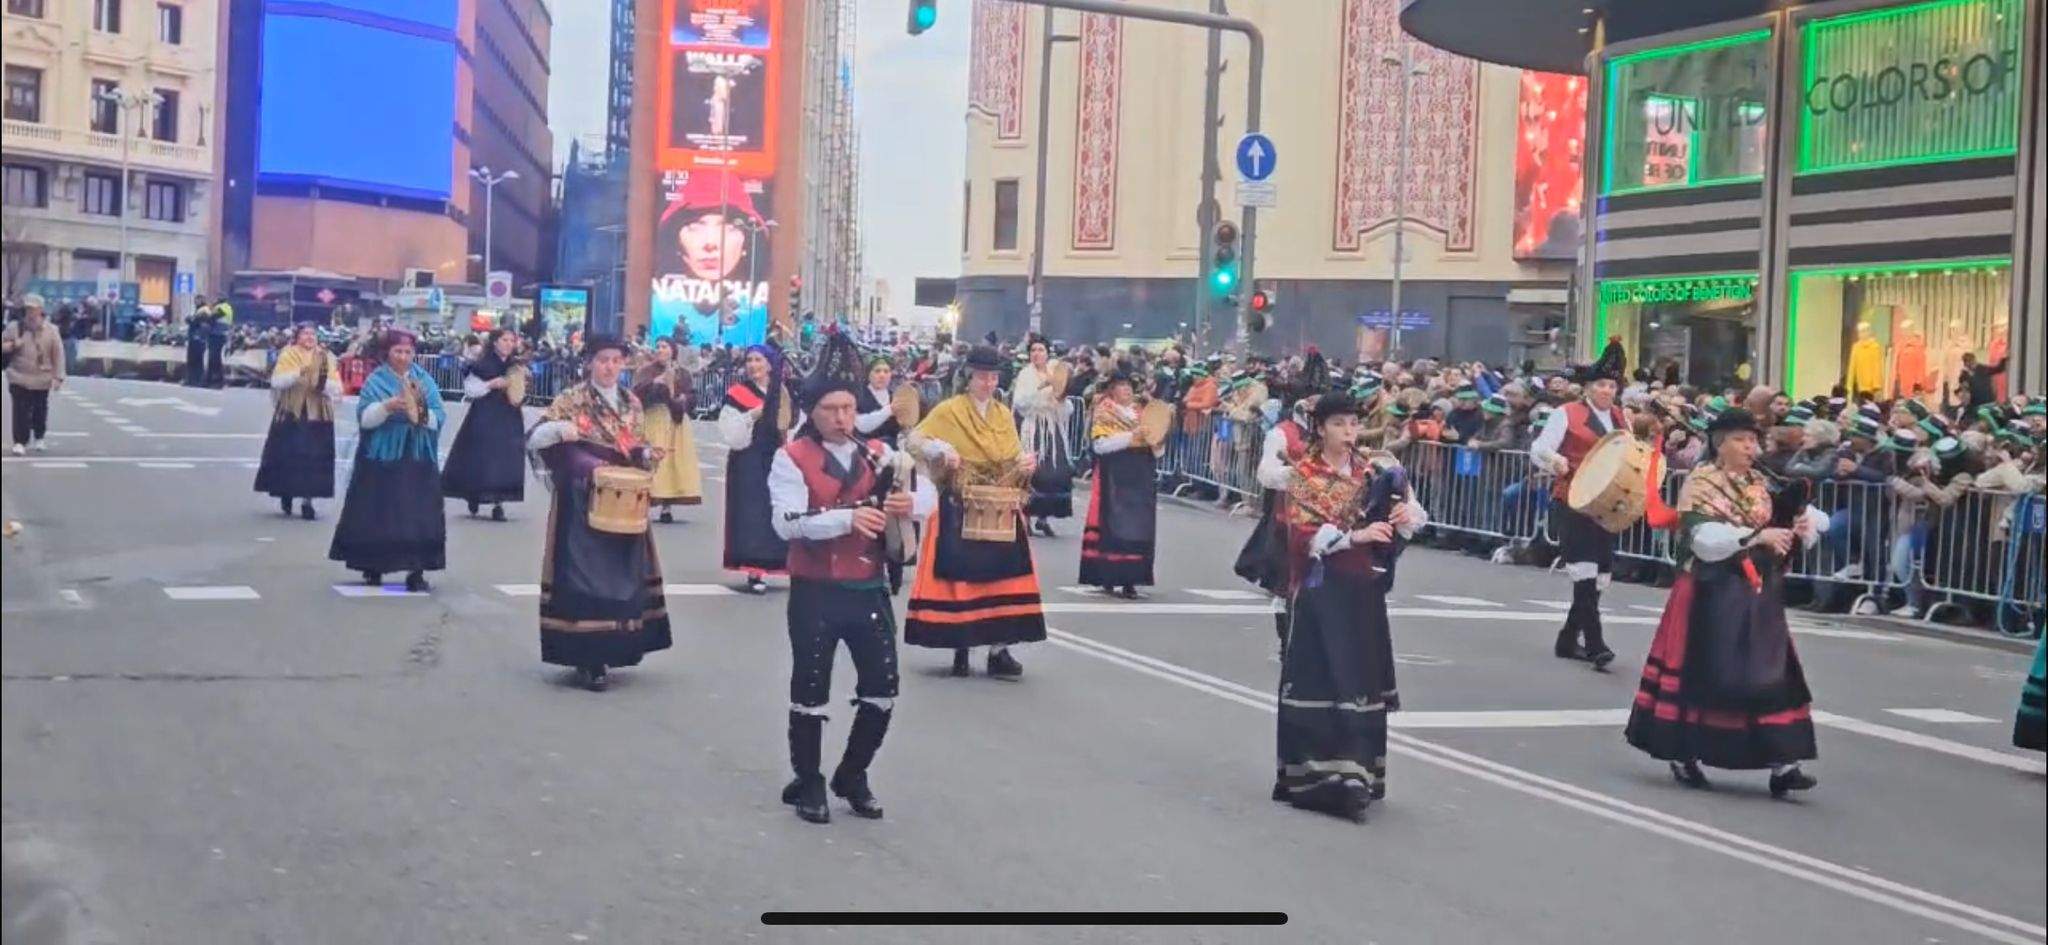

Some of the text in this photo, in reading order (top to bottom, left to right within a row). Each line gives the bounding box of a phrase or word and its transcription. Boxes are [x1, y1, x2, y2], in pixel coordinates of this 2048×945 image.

[1806, 49, 2018, 116] COLORS OF
[1655, 90, 1767, 136] UNITED
[652, 276, 769, 306] NATACHA
